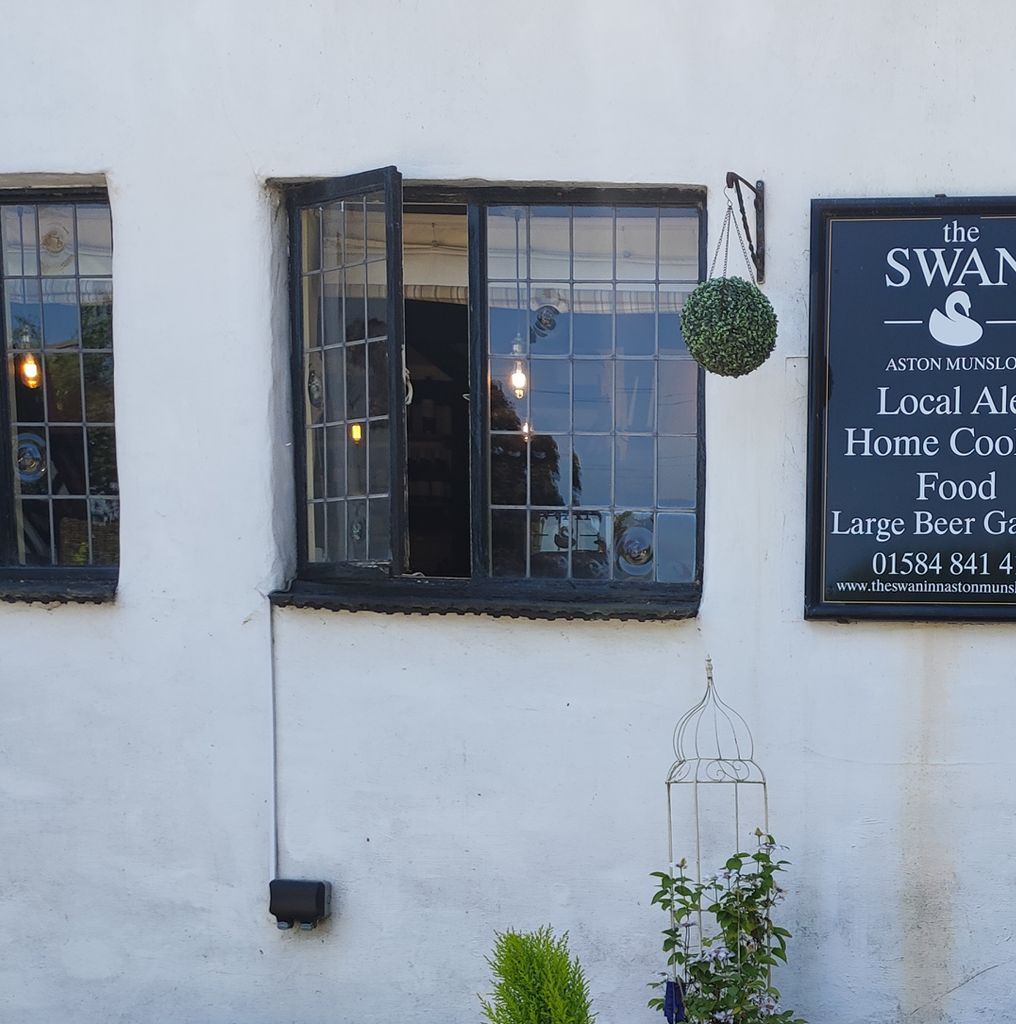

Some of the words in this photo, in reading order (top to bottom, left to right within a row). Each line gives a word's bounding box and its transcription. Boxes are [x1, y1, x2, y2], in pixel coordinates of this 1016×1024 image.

[943, 220, 980, 243] the
[885, 357, 942, 372] ASTON
[876, 386, 961, 416] Local
[843, 427, 940, 457] Home
[915, 471, 997, 501] Food
[830, 511, 906, 543] Large
[912, 510, 976, 535] Beer
[872, 553, 943, 575] 01584
[949, 552, 991, 576] 841
